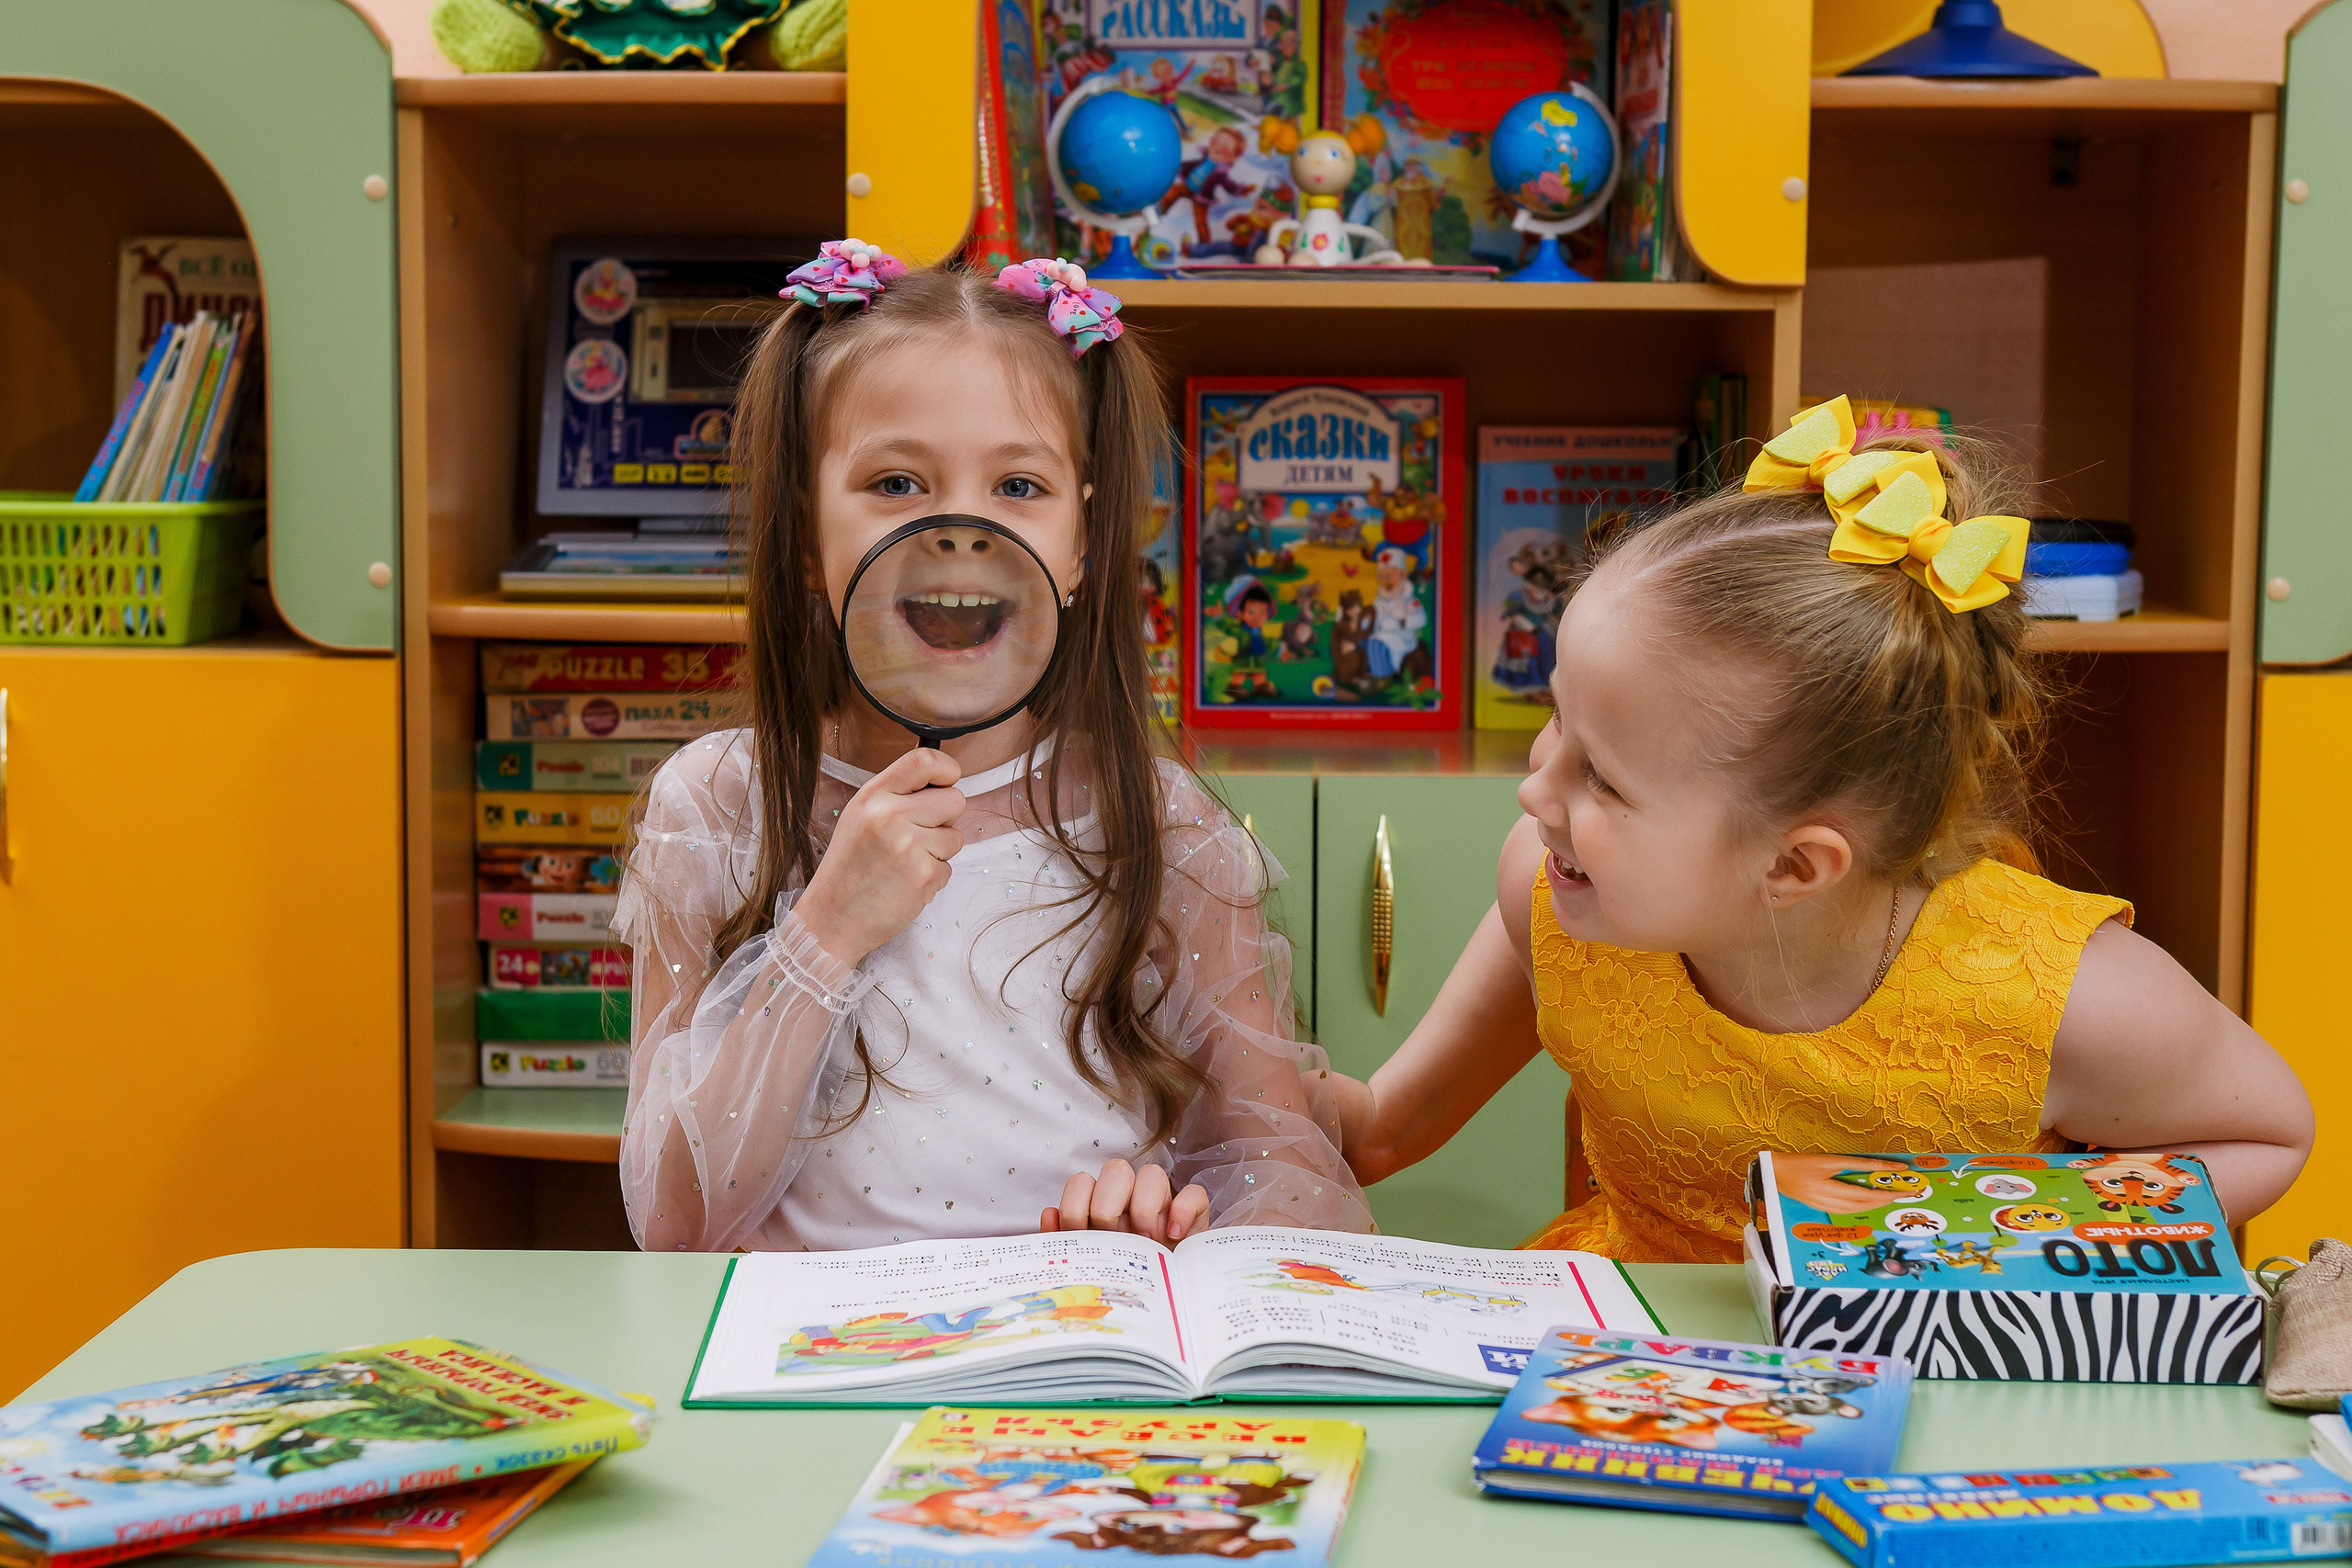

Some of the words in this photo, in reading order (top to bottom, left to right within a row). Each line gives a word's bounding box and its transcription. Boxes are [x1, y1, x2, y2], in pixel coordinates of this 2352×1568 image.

[1285, 465, 1353, 485] ДЕТЯМ
[1553, 464, 1645, 481] УРОКИ
[548, 654, 646, 682] PUZZLE
[679, 699, 711, 721] 24
[514, 808, 581, 827] Puzzle
[590, 804, 621, 826] 60
[497, 953, 524, 974] 24
[519, 1054, 587, 1073] Puzzle
[2084, 1224, 2209, 1237] ЖИВОТНЫЕ
[2040, 1238, 2222, 1278] ЛОТО
[1555, 1331, 1882, 1377] БУКВАРЬ
[940, 1424, 1308, 1445] ВЕСЁЛЫЕ
[993, 1415, 1274, 1432] ДРУЗЬЯ
[399, 1463, 461, 1493] ЗМЕЙ
[277, 1476, 390, 1517] ГОРЫНЫЧ
[1879, 1489, 2201, 1523] ДОМИНО
[113, 1503, 241, 1543] ВАСИЛИСА
[251, 1499, 268, 1524] И
